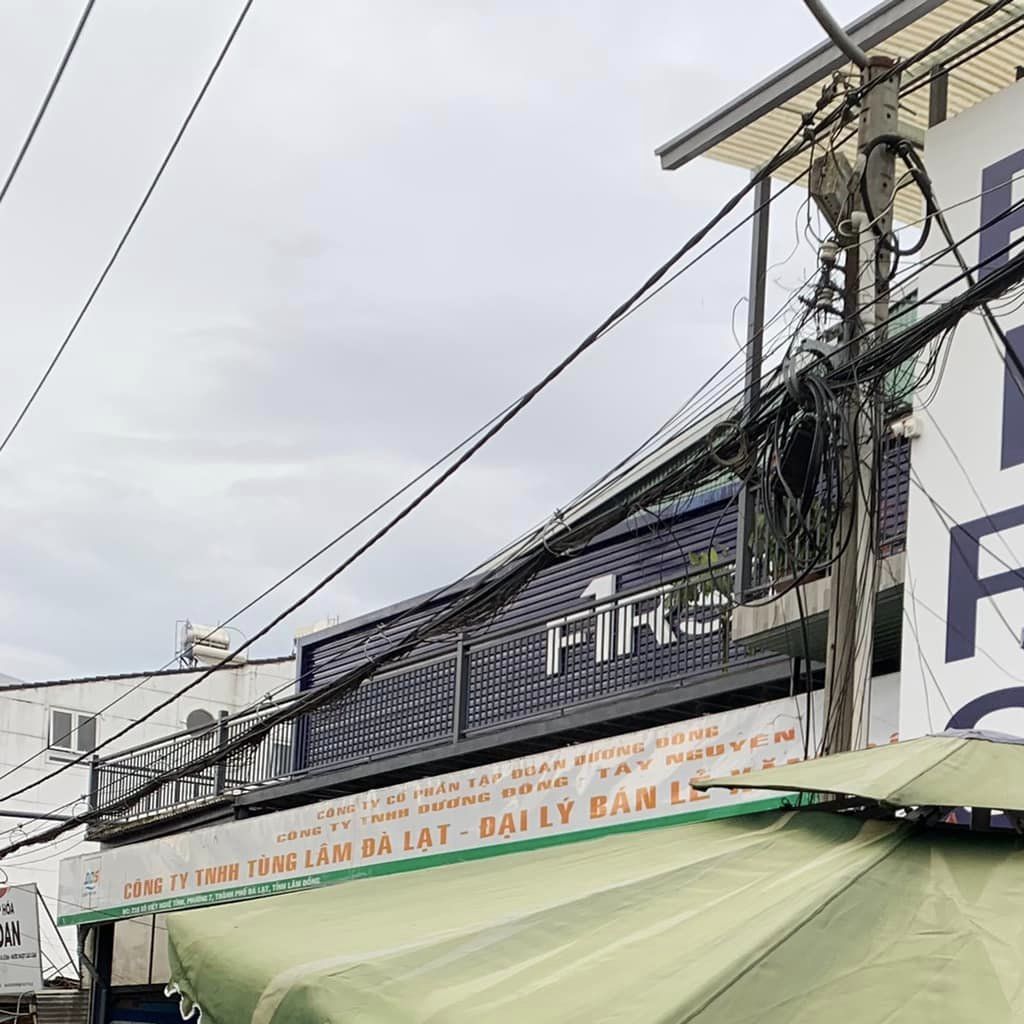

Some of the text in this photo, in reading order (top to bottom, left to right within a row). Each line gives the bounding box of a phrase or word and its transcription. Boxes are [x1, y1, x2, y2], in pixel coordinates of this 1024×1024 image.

[123, 878, 163, 900] CÔNG
[169, 872, 188, 891] TY
[196, 863, 240, 888] TNHH
[247, 854, 297, 878] TÙNG
[304, 841, 353, 868] LÂM
[361, 831, 393, 858] ĐÀ
[402, 823, 451, 852] LẠT
[479, 809, 528, 839] ĐẠI
[539, 797, 575, 828] LÝ
[589, 785, 657, 820] BÁN
